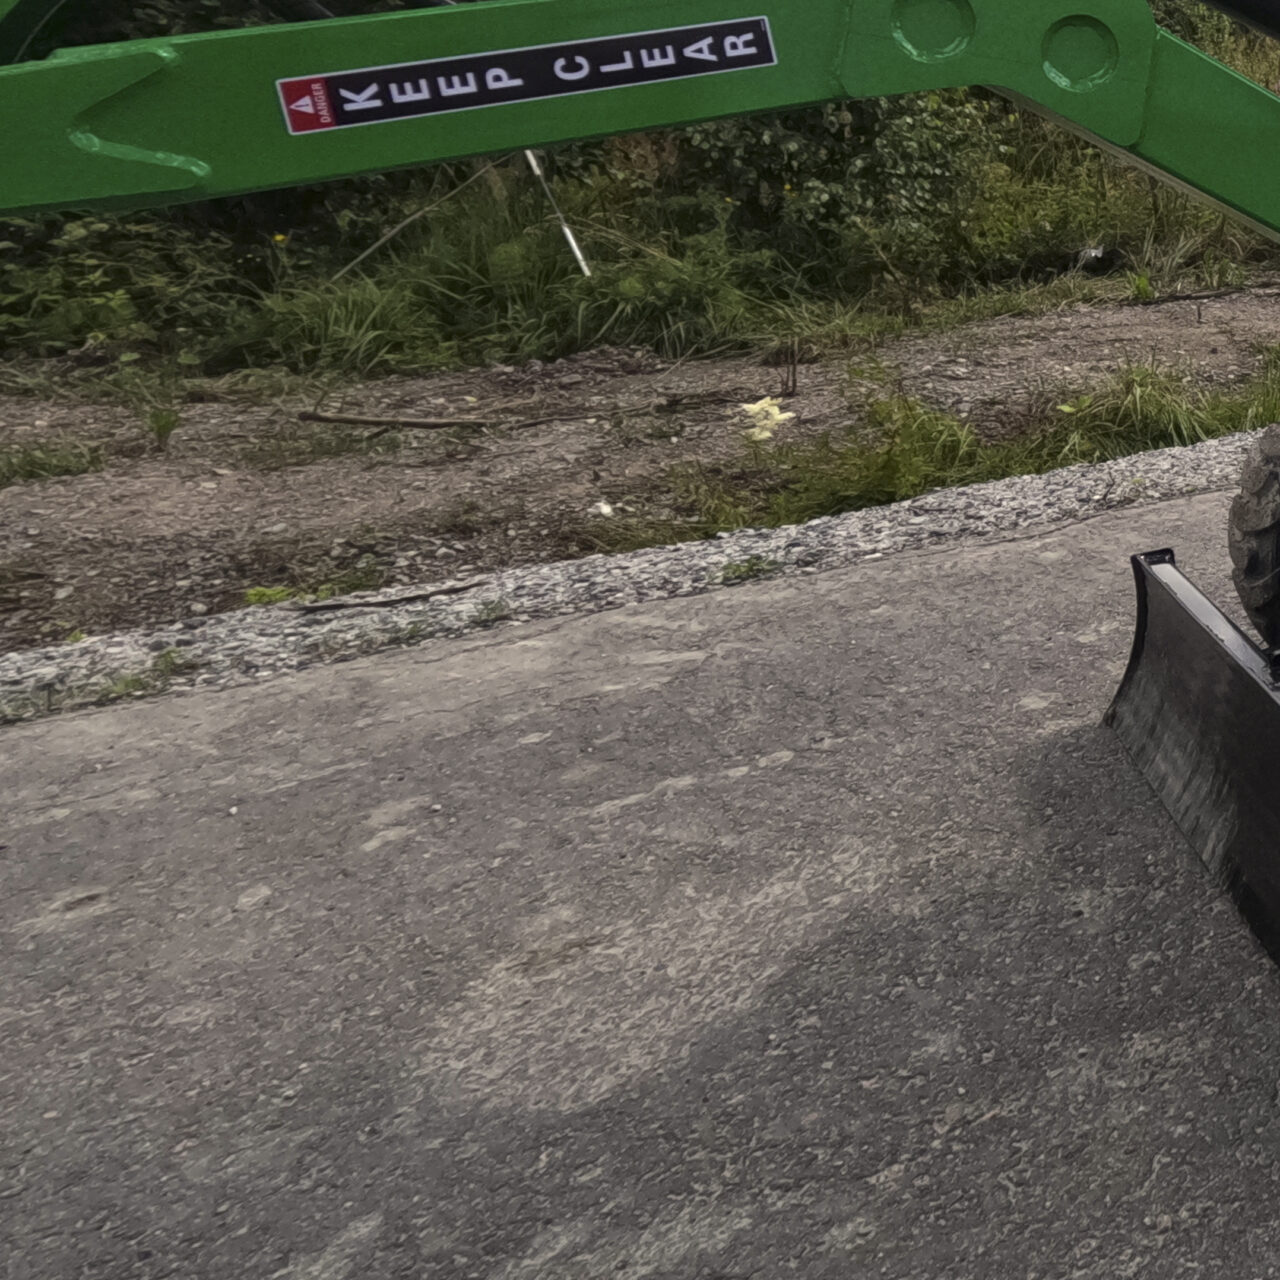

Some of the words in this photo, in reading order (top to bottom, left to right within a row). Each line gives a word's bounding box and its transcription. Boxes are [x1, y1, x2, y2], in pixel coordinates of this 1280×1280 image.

[339, 67, 524, 111] KEEP
[554, 33, 757, 81] CLEAR
[311, 83, 332, 123] DANGER
